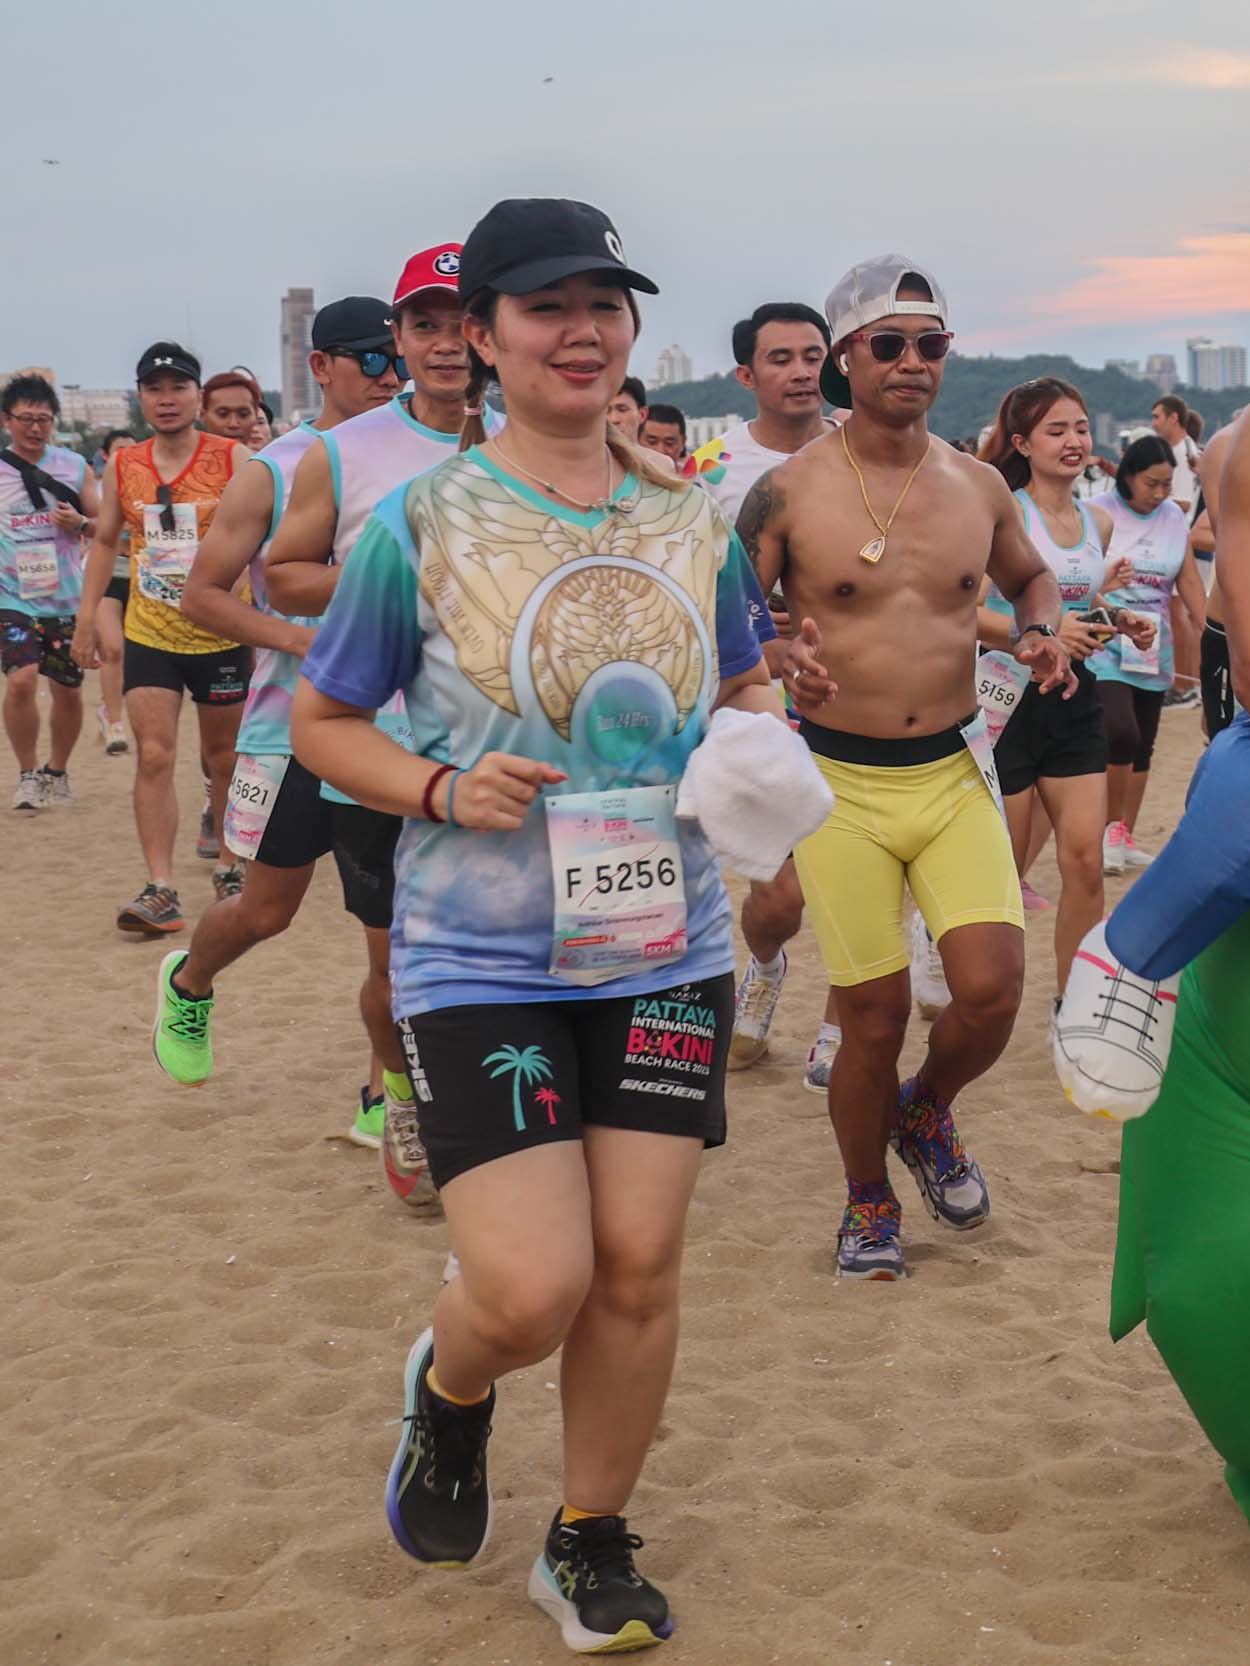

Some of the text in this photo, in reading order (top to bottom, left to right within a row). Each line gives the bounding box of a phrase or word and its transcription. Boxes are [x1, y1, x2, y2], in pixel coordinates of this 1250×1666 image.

[978, 680, 1015, 706] 5159
[595, 858, 676, 894] 5256
[633, 999, 717, 1027] PATTAYA
[631, 1016, 715, 1039] INTERNATIONAL
[624, 1054, 662, 1067] BEACH
[664, 1058, 691, 1072] RACE
[618, 1078, 707, 1101] SKECHERS
